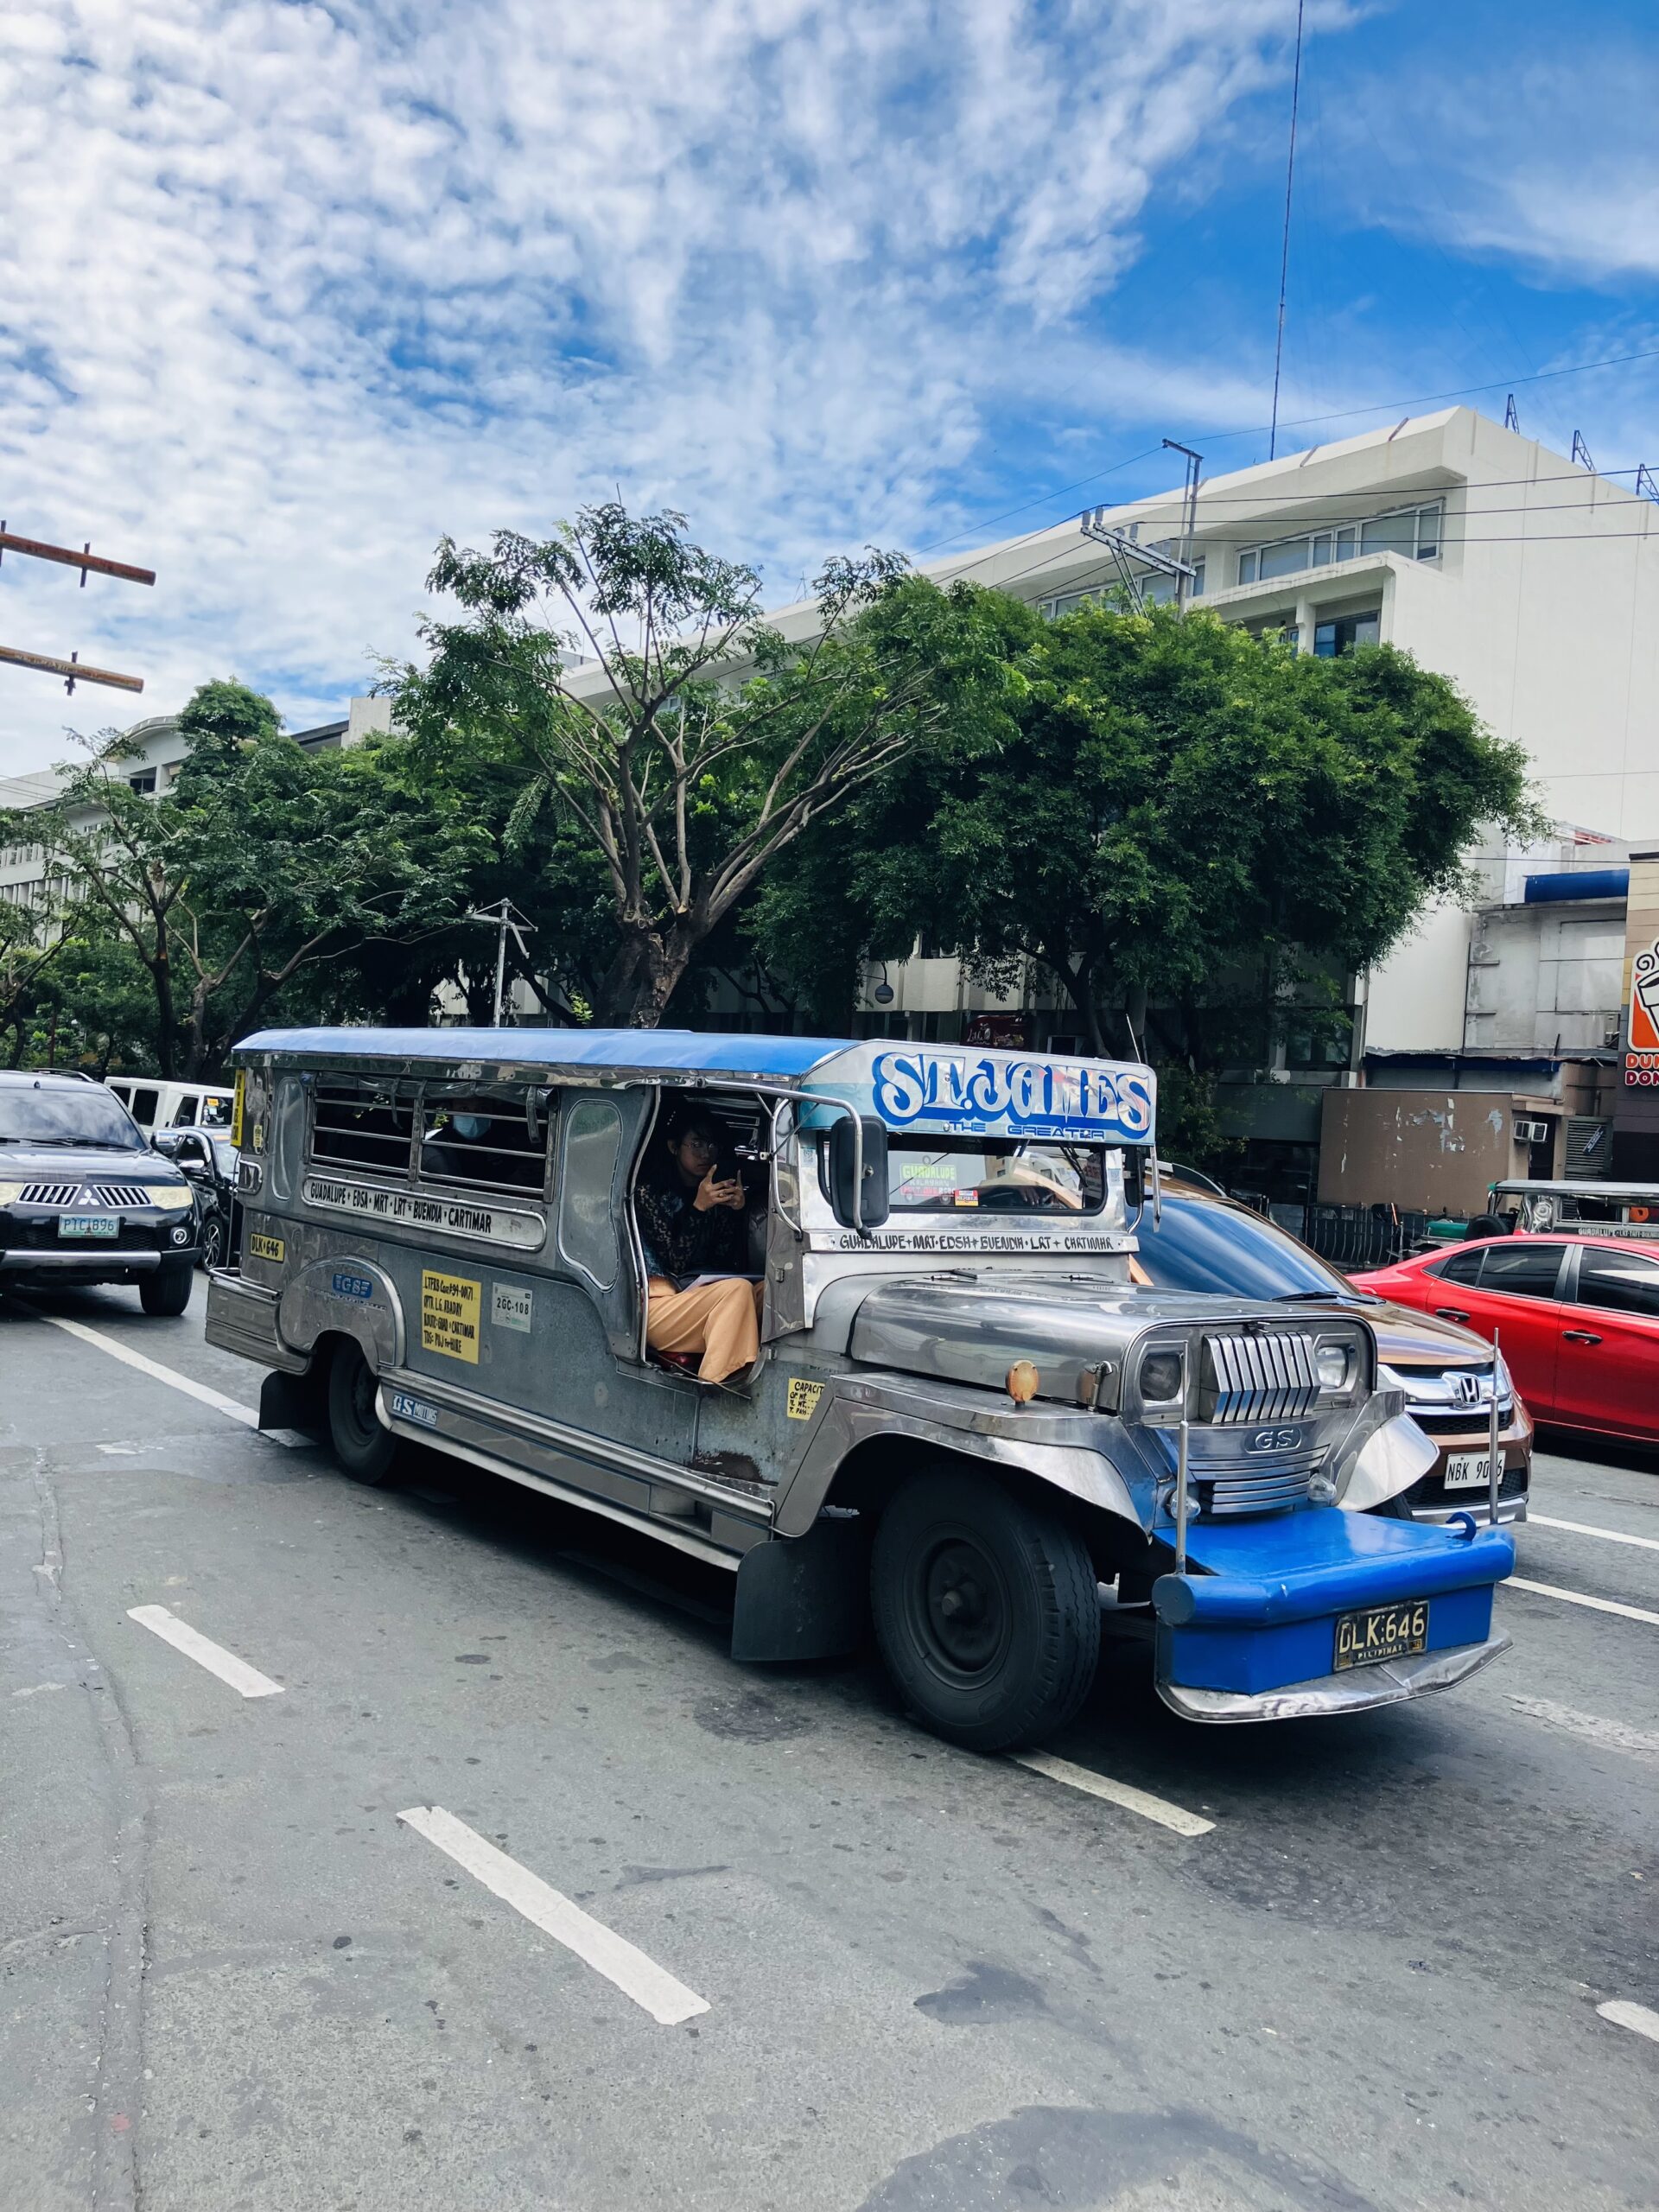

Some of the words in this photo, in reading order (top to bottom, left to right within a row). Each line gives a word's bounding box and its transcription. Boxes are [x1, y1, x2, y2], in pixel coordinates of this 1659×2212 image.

[949, 1122, 986, 1133] THE
[1007, 1124, 1104, 1140] GREATER
[902, 1165, 956, 1180] GUADALUPE
[310, 1182, 346, 1205] GUADALUPE
[353, 1189, 368, 1210] EDSA
[373, 1193, 389, 1213] MRT
[393, 1196, 407, 1217] LRT
[413, 1200, 442, 1224] BUENDIA
[448, 1207, 492, 1233] CARTIMAR
[92, 1218, 114, 1231] 896
[913, 1235, 935, 1249] MRT
[939, 1236, 971, 1249] EDSA
[980, 1236, 1024, 1250] BUENDIA
[1030, 1236, 1051, 1250] LRT
[1065, 1236, 1114, 1250] CARTIMAR
[497, 1297, 529, 1315] 2GC-108
[794, 1381, 825, 1395] CAPACIT
[393, 1395, 414, 1415] GS
[1255, 1429, 1294, 1450] GS
[1447, 1462, 1469, 1482] NBK
[1476, 1459, 1503, 1480] 906
